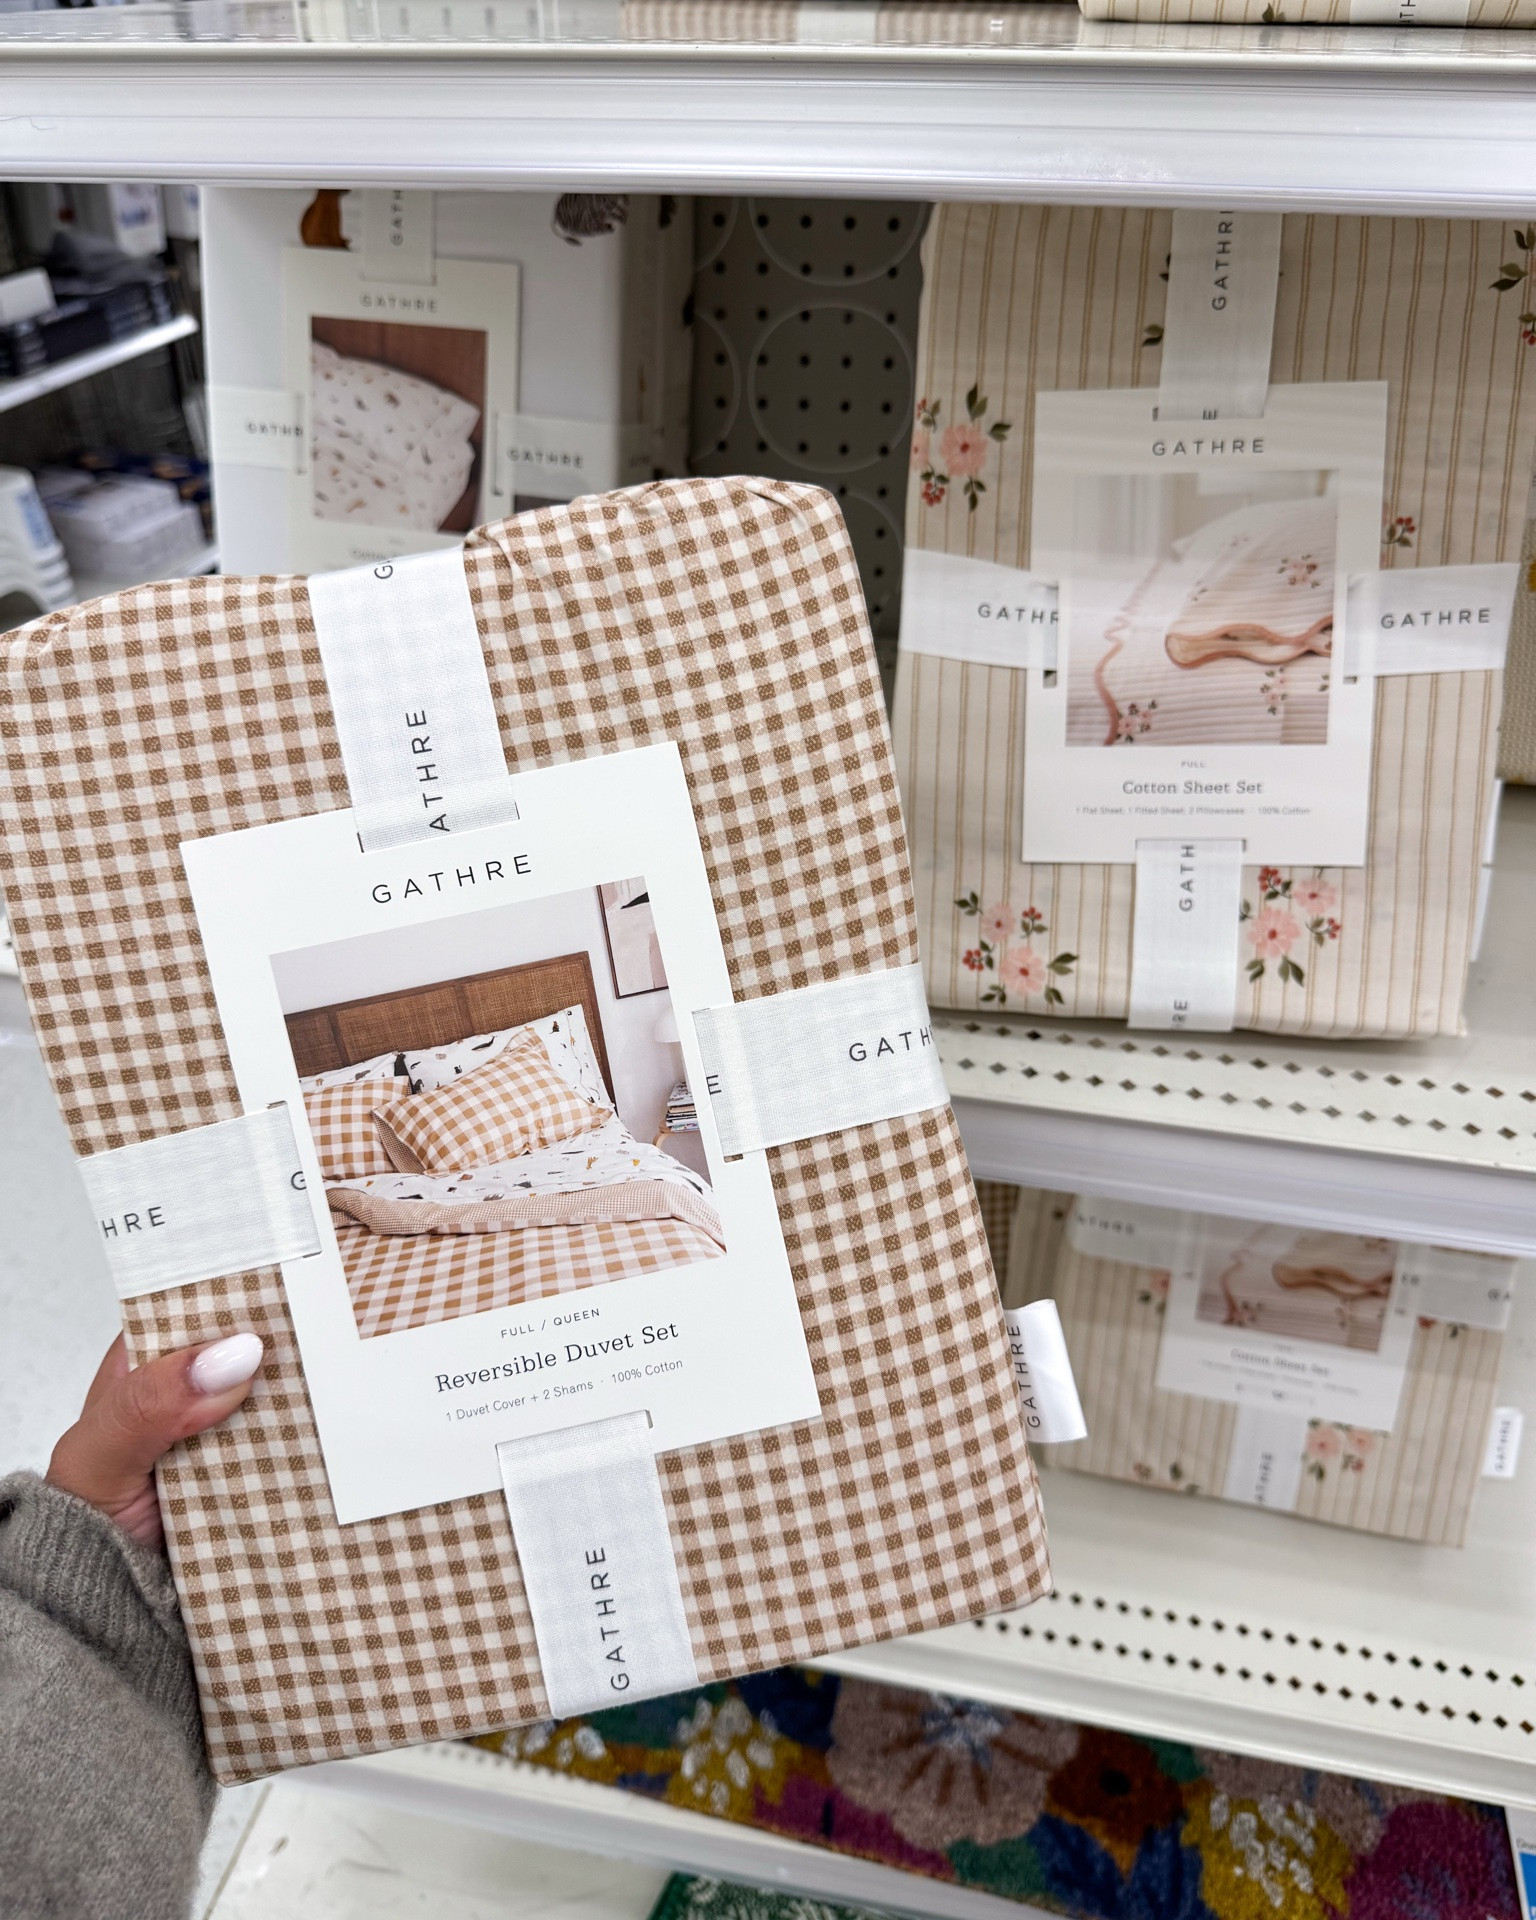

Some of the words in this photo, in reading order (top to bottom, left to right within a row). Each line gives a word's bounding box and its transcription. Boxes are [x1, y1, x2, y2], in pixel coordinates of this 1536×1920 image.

[1211, 210, 1234, 311] GATHR
[1152, 438, 1264, 456] GATHRE
[1380, 607, 1491, 630] GATHRE
[1122, 781, 1177, 795] Cotton
[1183, 780, 1231, 795] Sheet
[1236, 780, 1264, 795] Set
[372, 854, 532, 904] GATHRE
[849, 1024, 933, 1062] GATH
[500, 1323, 535, 1339] FULL
[553, 1308, 601, 1327] QUEEN
[435, 1351, 558, 1393] Reversible
[564, 1333, 635, 1363] Duvet
[641, 1322, 680, 1346] Set
[1007, 1325, 1041, 1428] GATHRE
[446, 1411, 452, 1422] 1
[456, 1404, 490, 1421] Duvet
[493, 1396, 527, 1412] Cover
[543, 1389, 551, 1400] 2
[553, 1380, 595, 1398] Shams
[611, 1368, 643, 1384] 100%
[645, 1358, 684, 1377] Cotton
[586, 1547, 630, 1691] GATHRE
